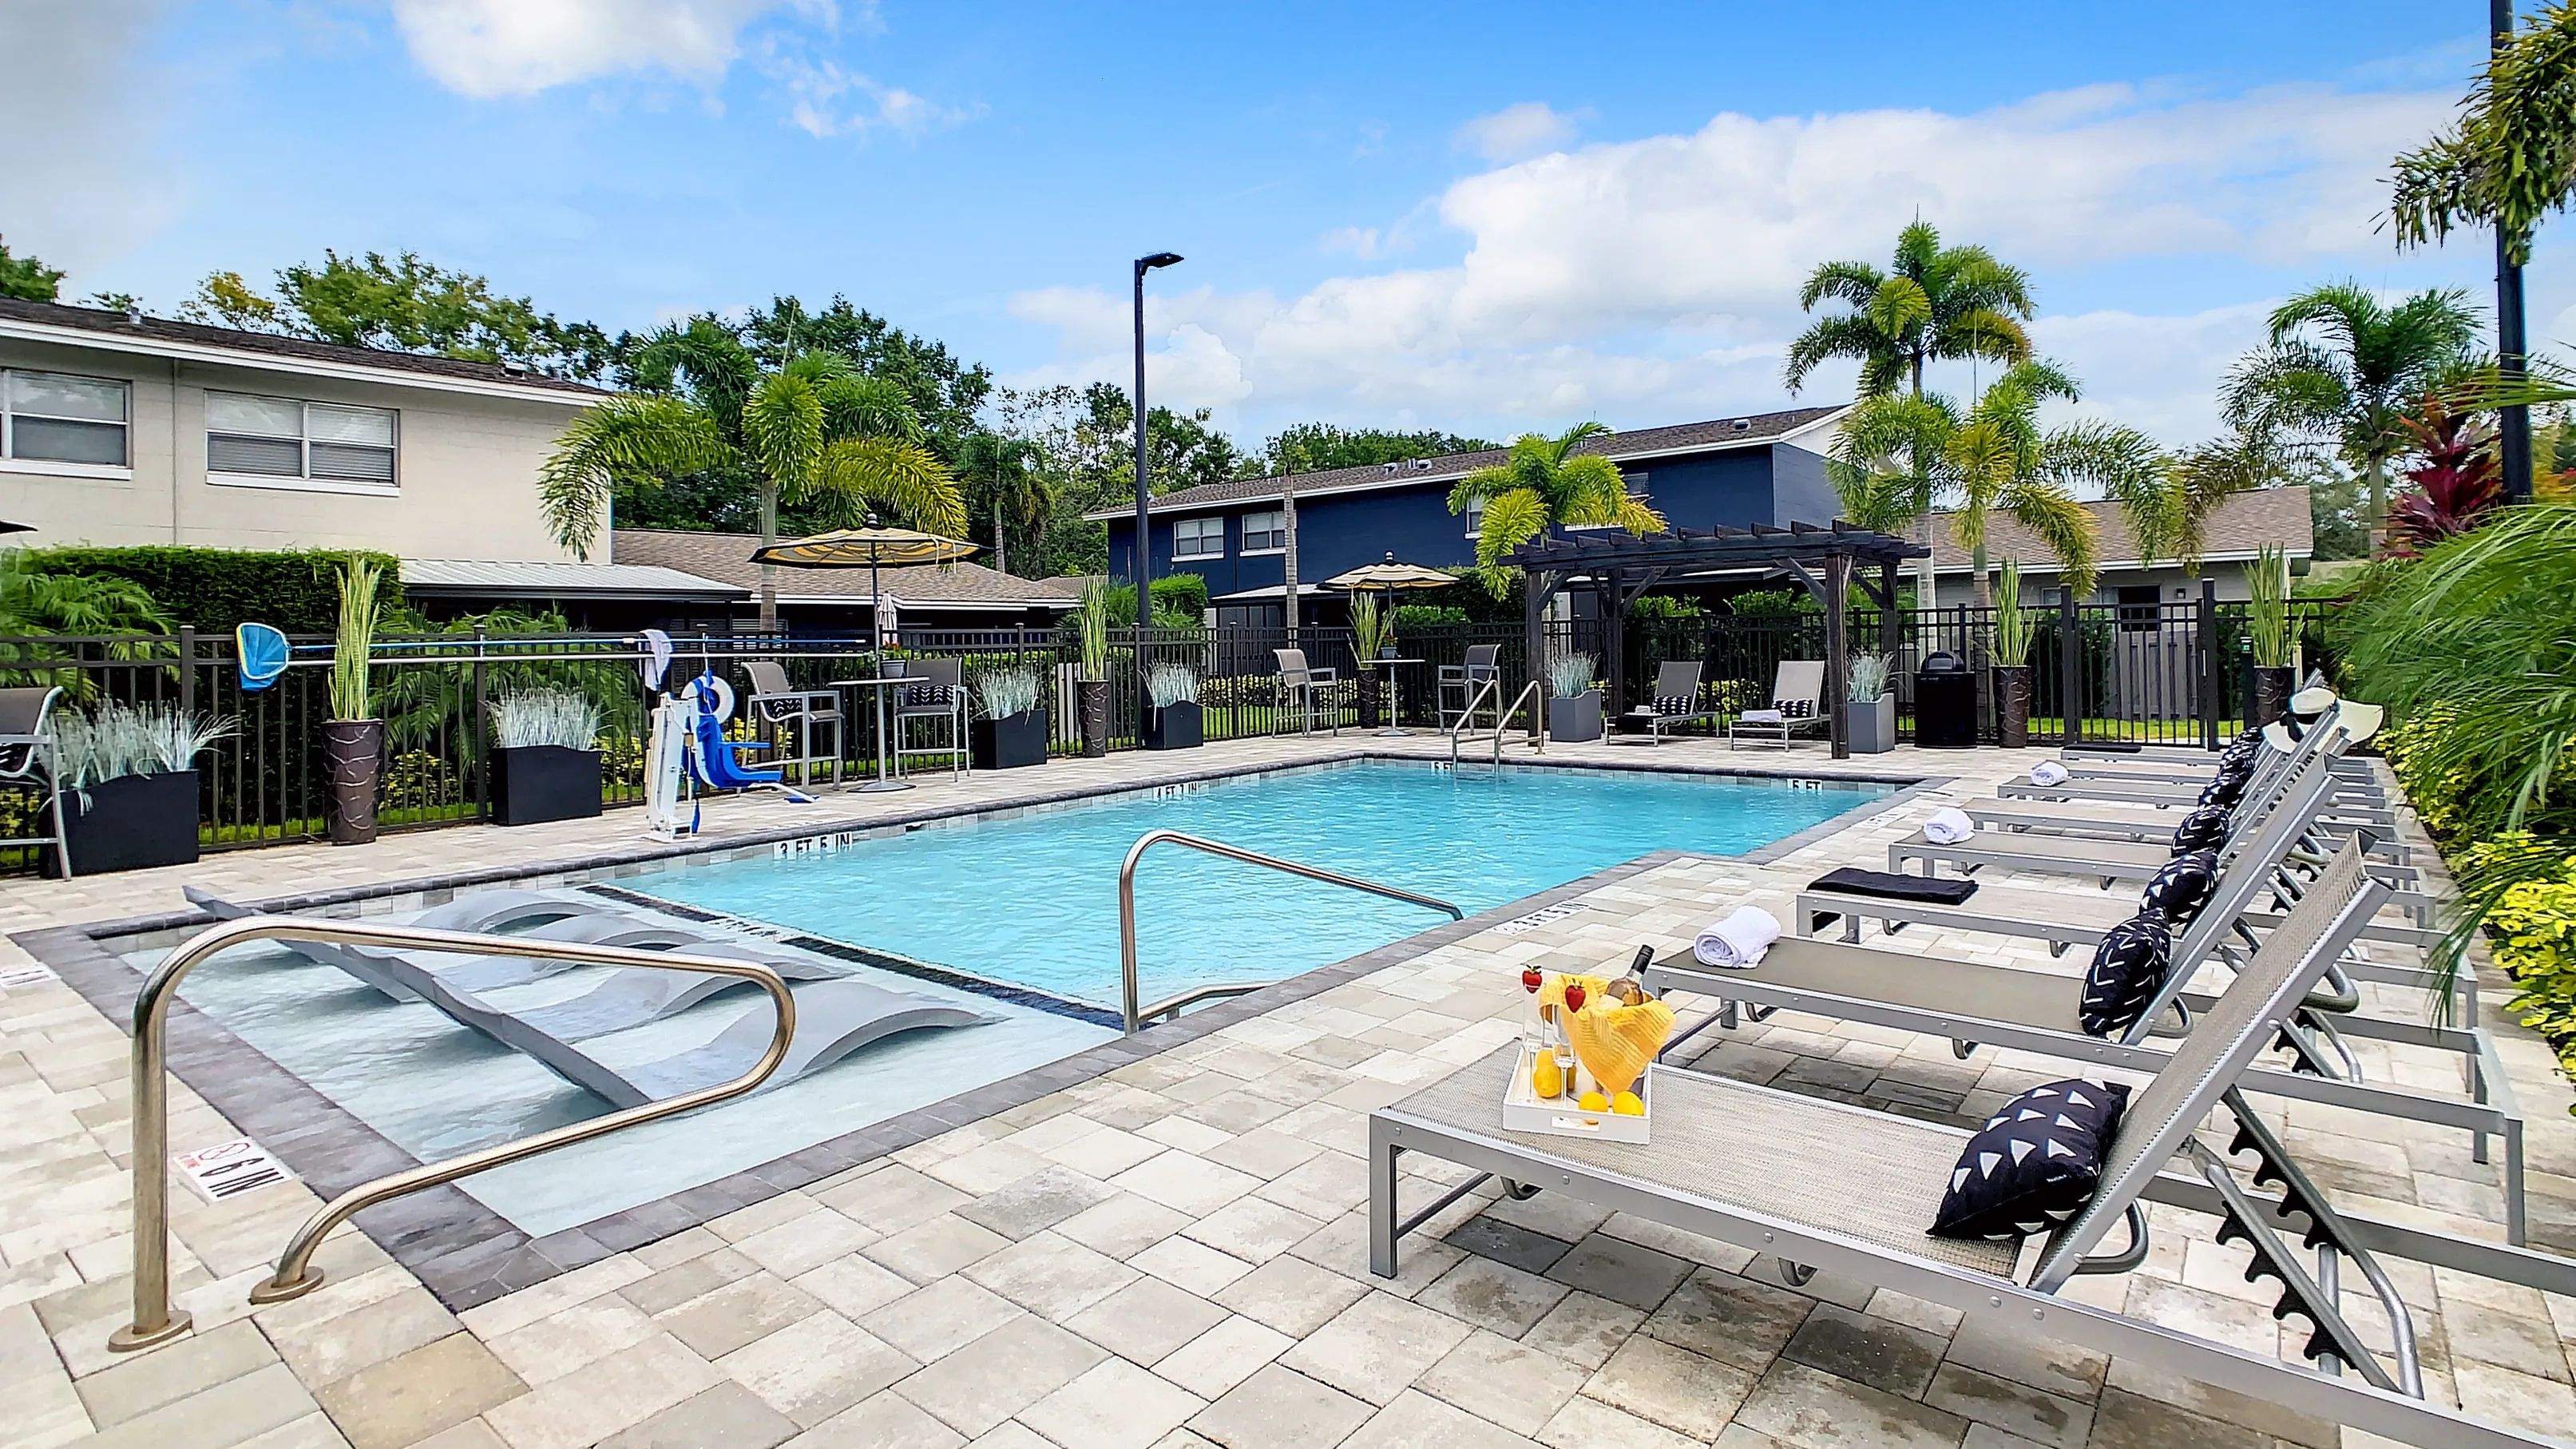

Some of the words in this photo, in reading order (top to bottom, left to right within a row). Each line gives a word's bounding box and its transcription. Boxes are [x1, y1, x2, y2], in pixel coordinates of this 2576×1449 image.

[1166, 785, 1175, 797] FT
[1188, 782, 1197, 796] IN
[1805, 780, 1821, 791] FT
[795, 838, 813, 853] FT
[835, 832, 850, 853] IN
[200, 1157, 265, 1177] 6
[208, 1167, 284, 1198] IN
